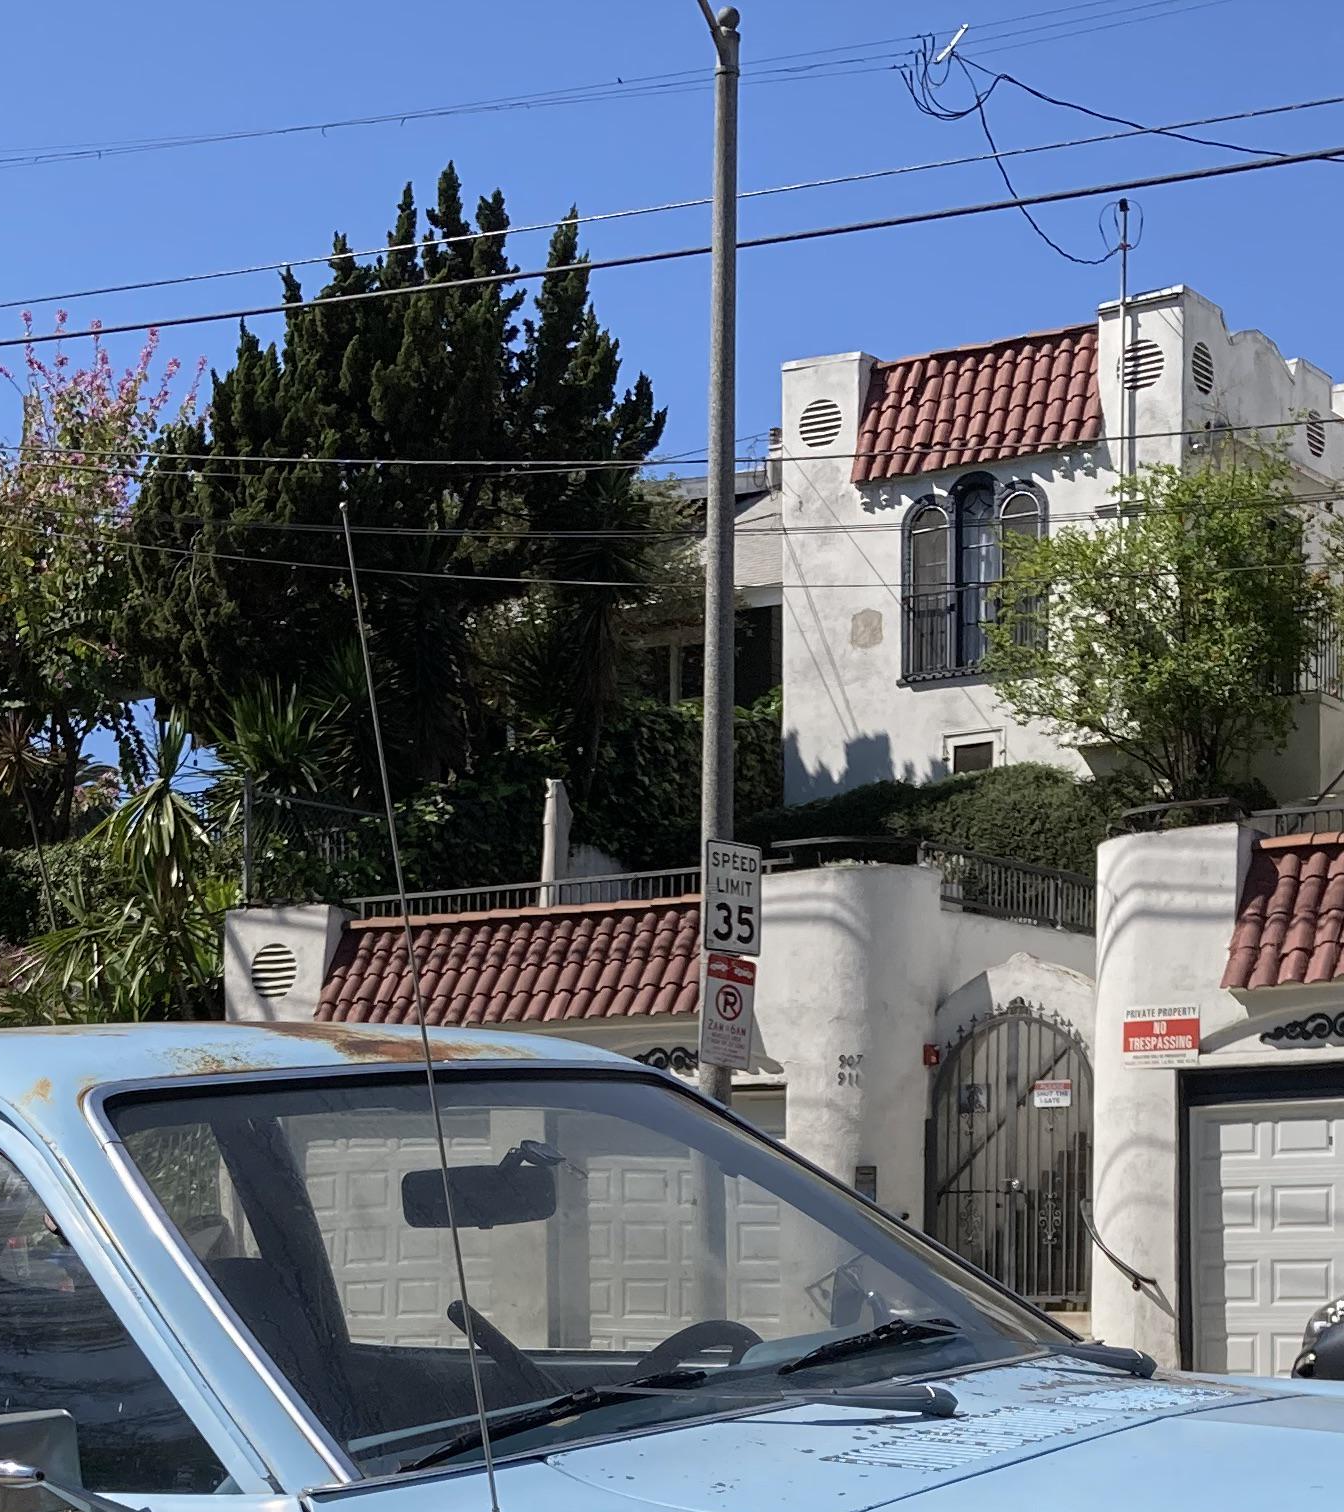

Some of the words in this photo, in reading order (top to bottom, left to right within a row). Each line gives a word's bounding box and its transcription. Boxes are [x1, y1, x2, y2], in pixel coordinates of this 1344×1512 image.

[712, 851, 757, 873] SPEED
[717, 877, 753, 897] LIMIT
[713, 902, 755, 944] 35
[1126, 1008, 1156, 1019] PRIVATE
[1158, 1006, 1197, 1018] PROPERTY
[1152, 1021, 1168, 1035] NO
[1128, 1035, 1193, 1051] TRESPASSING
[838, 1072, 860, 1088] 911
